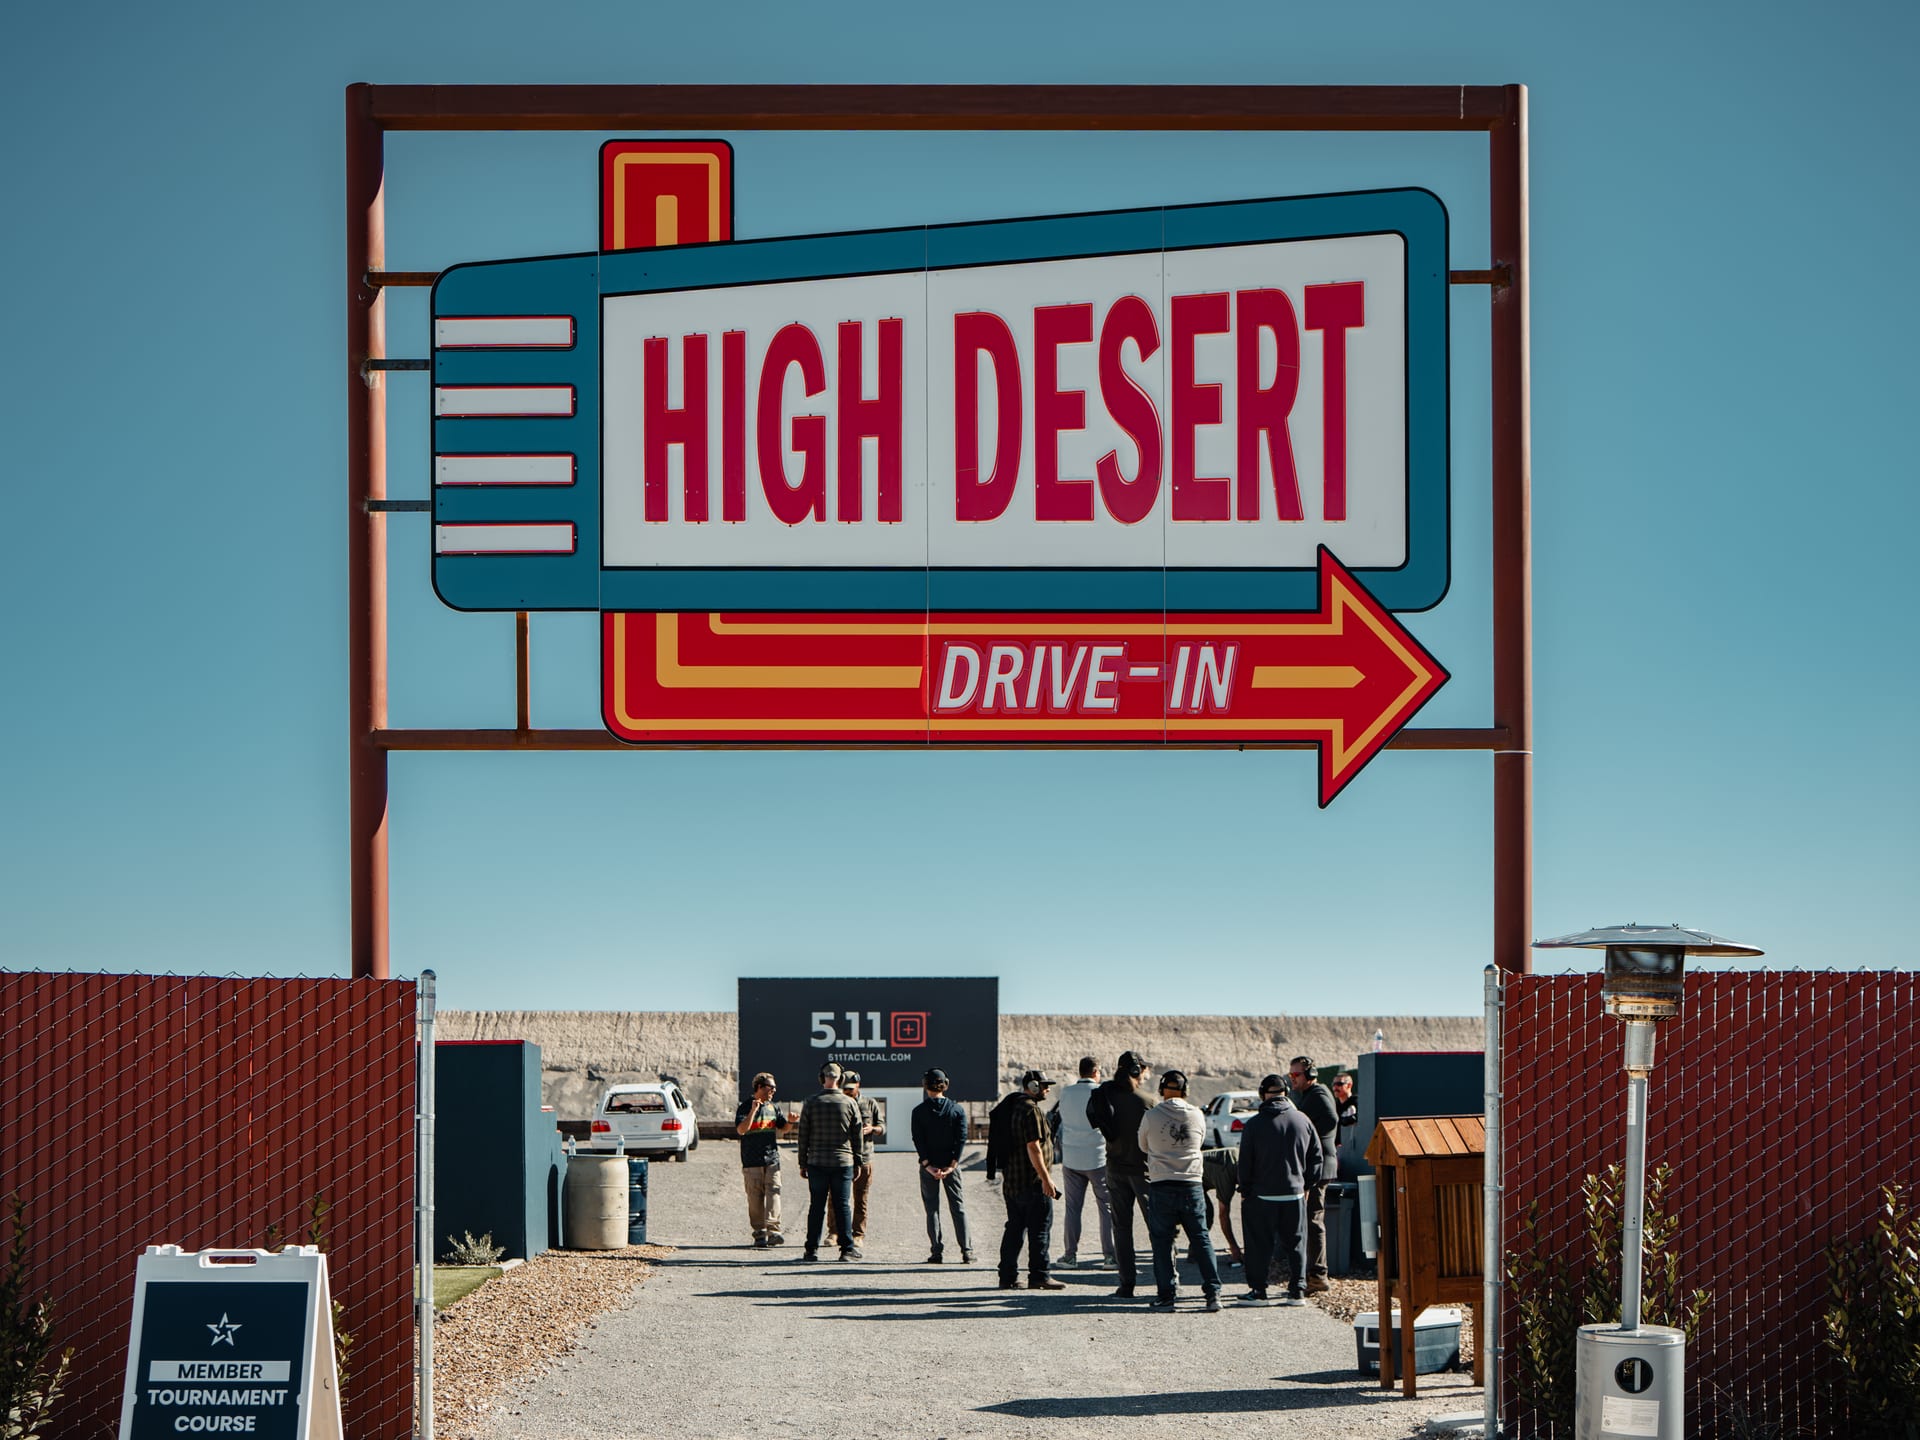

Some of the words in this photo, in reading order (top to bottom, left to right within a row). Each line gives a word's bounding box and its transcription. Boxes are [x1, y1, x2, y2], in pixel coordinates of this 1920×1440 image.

[643, 317, 903, 525] HIGH
[954, 280, 1365, 525] DESERT
[937, 645, 1237, 710] DRIVE-IN
[810, 1011, 887, 1048] 5.11
[827, 1052, 912, 1062] 511TACTICAL.COM
[177, 1363, 263, 1379] MEMBER
[147, 1389, 288, 1406] TOURNAMENT
[174, 1415, 257, 1432] COURSE
